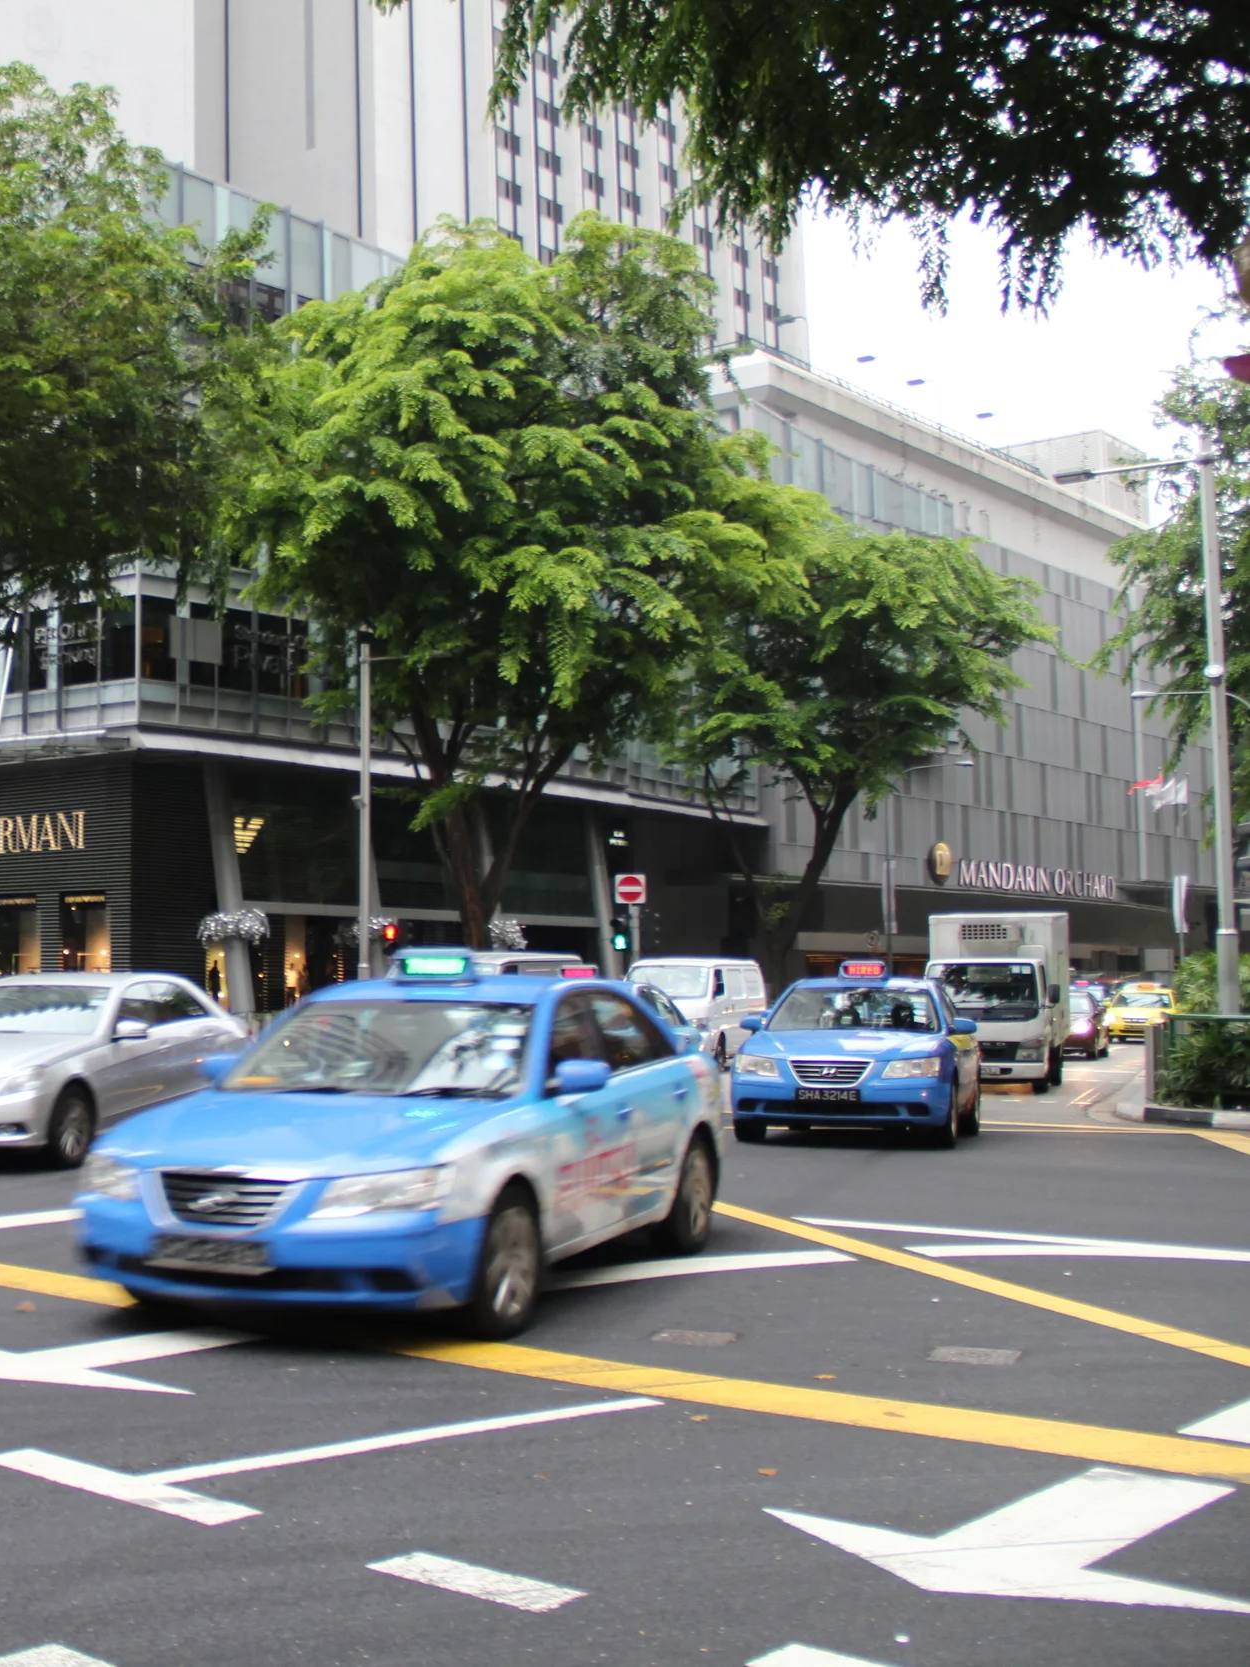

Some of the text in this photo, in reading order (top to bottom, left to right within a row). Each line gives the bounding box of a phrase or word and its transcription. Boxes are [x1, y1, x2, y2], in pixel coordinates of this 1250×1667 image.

[958, 859, 1117, 900] MANDARIN ORCHARD
[849, 965, 881, 976] HIRED
